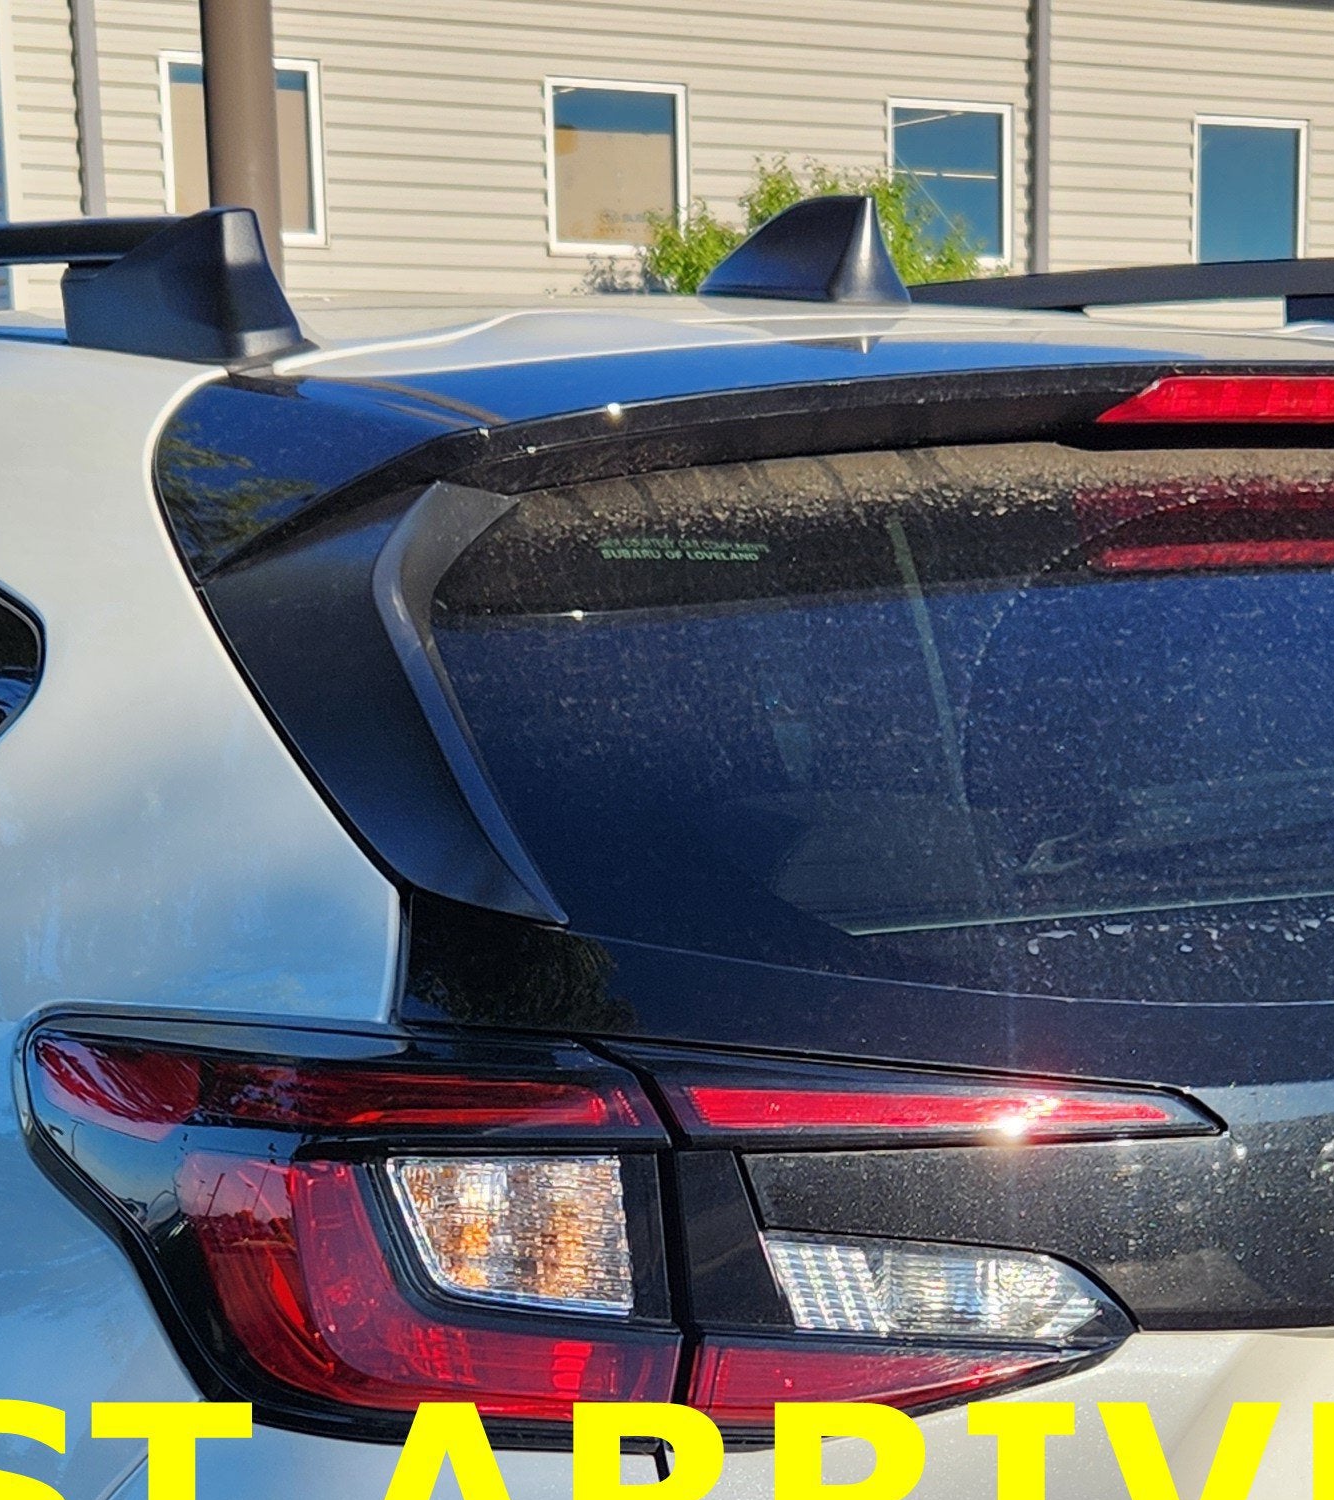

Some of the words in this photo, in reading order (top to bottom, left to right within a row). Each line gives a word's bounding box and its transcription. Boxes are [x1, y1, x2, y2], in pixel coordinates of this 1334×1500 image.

[601, 549, 662, 560] SUBARU
[665, 550, 683, 560] OF
[686, 551, 759, 561] LOVELAND
